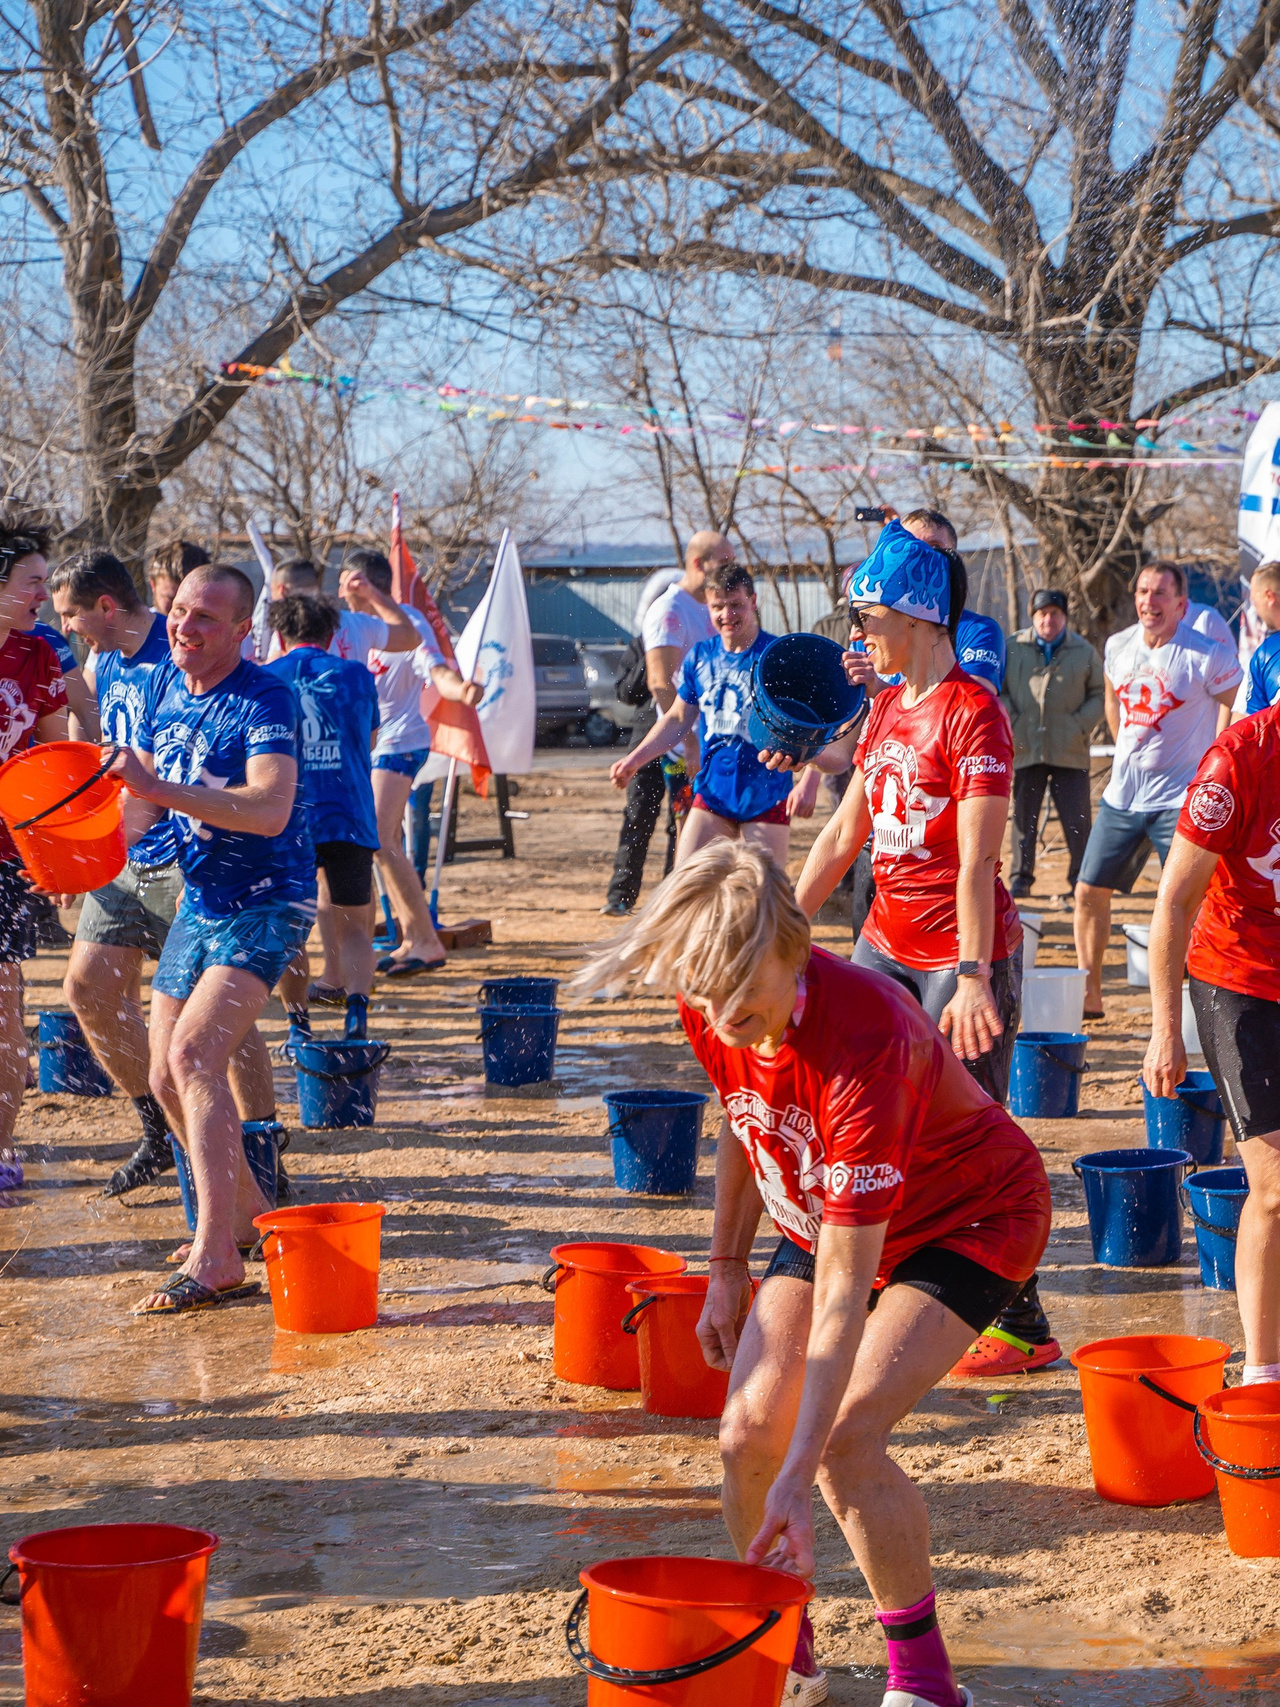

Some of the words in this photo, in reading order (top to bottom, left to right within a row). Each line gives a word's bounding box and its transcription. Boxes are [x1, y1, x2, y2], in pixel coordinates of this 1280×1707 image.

[965, 754, 997, 765] ПУТЬ
[966, 763, 1007, 776] ДОМОЙ
[853, 1162, 894, 1179] ПУТЬ
